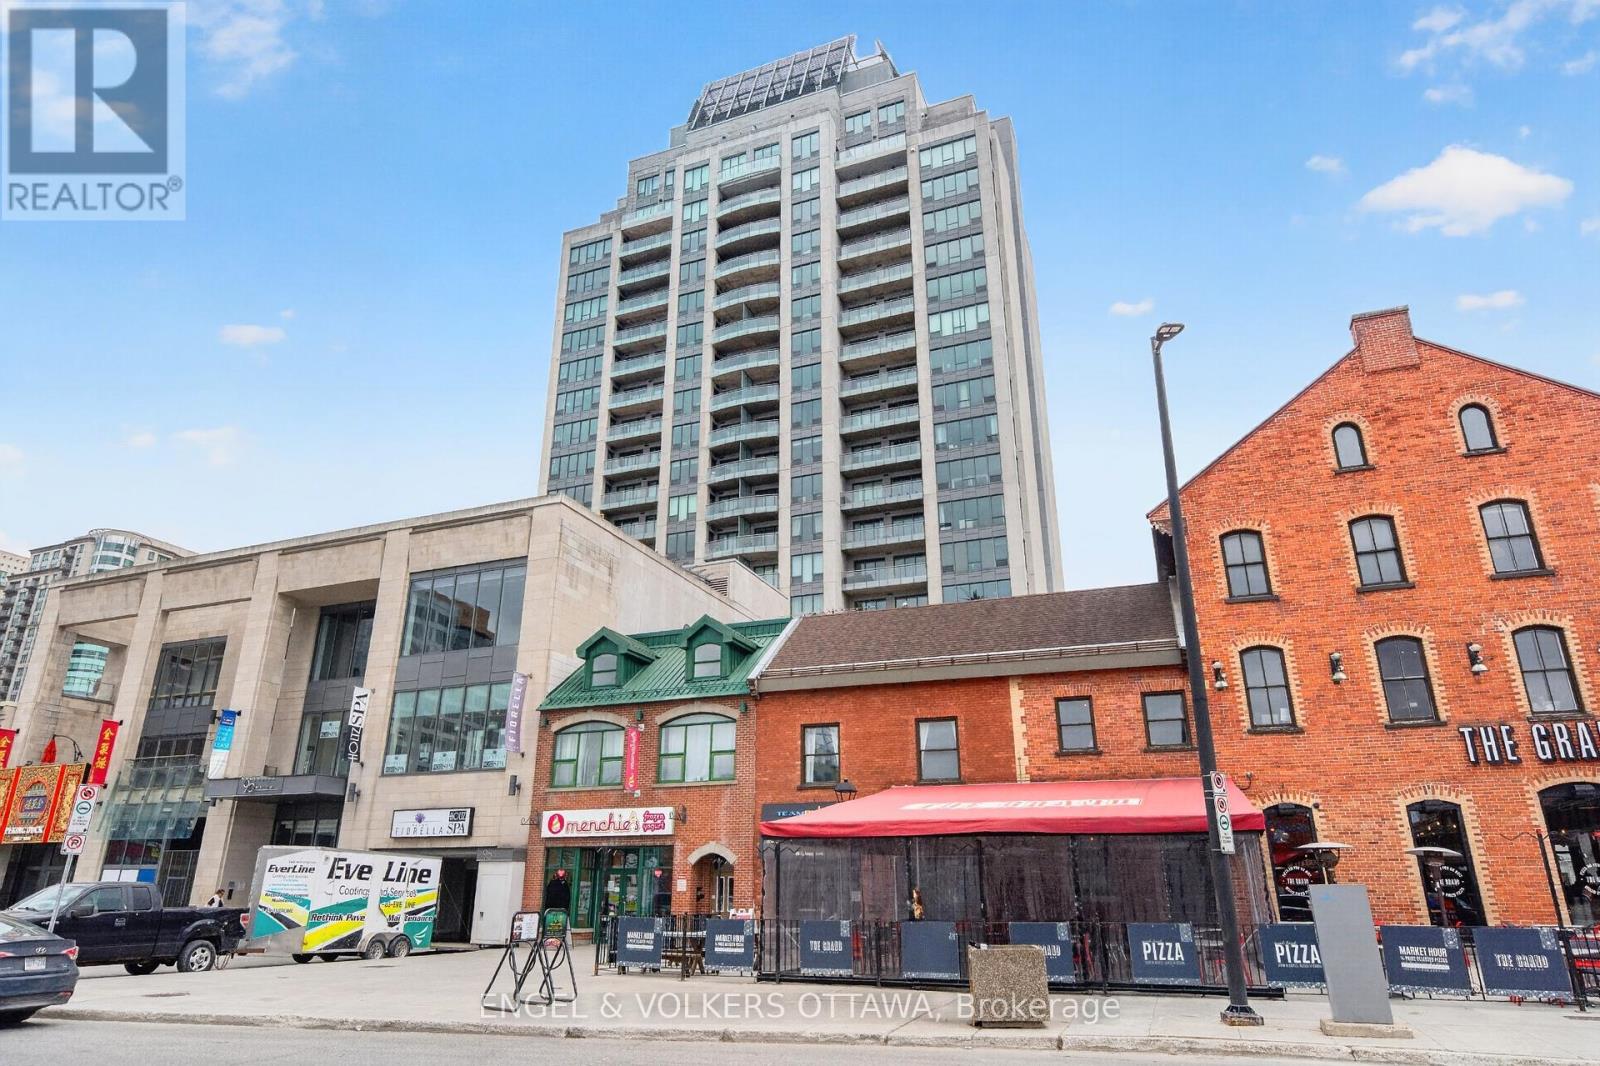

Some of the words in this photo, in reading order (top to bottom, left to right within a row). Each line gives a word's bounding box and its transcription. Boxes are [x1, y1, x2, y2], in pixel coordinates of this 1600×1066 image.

[508, 677, 525, 743] FIORELLA
[1459, 724, 1519, 763] THE
[1531, 721, 1600, 761] GRA
[447, 823, 465, 835] SPA
[268, 864, 315, 874] EverLine
[1142, 941, 1185, 961] PIZZA
[1274, 944, 1322, 964] PIZZA
[1398, 946, 1427, 956] MARKET
[1427, 947, 1448, 957] HOUR
